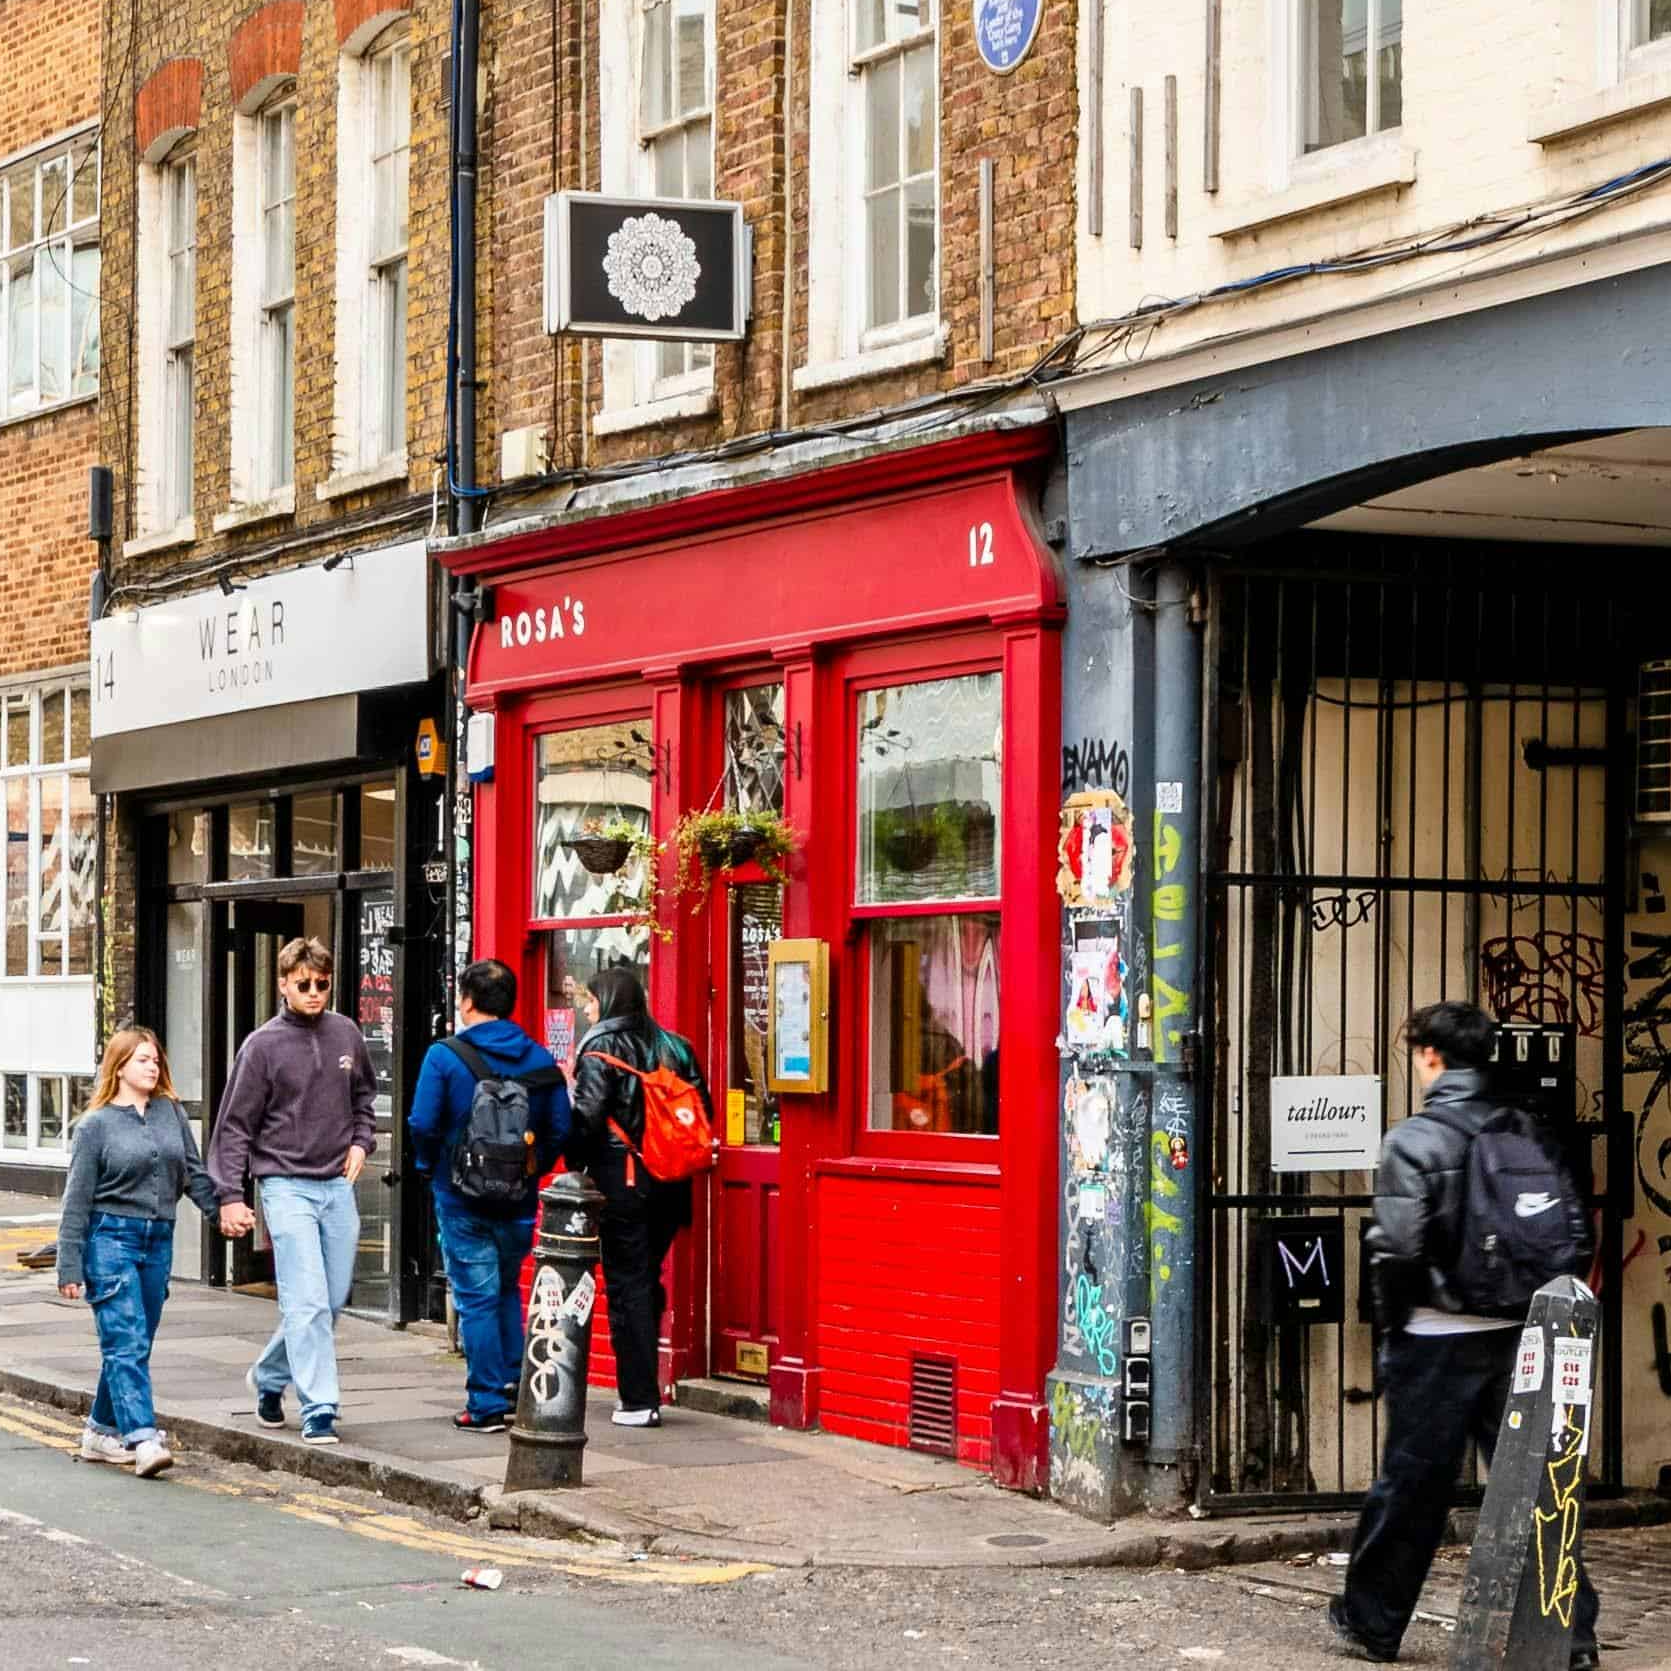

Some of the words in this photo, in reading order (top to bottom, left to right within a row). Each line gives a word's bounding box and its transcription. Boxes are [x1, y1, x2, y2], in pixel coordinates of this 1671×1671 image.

[969, 522, 995, 567] 12
[199, 600, 285, 661] WEAR
[501, 594, 586, 649] ROSA'S
[96, 648, 115, 702] 14
[208, 659, 273, 693] LONDON
[1286, 1097, 1367, 1123] taillour;
[1278, 1236, 1331, 1288] M
